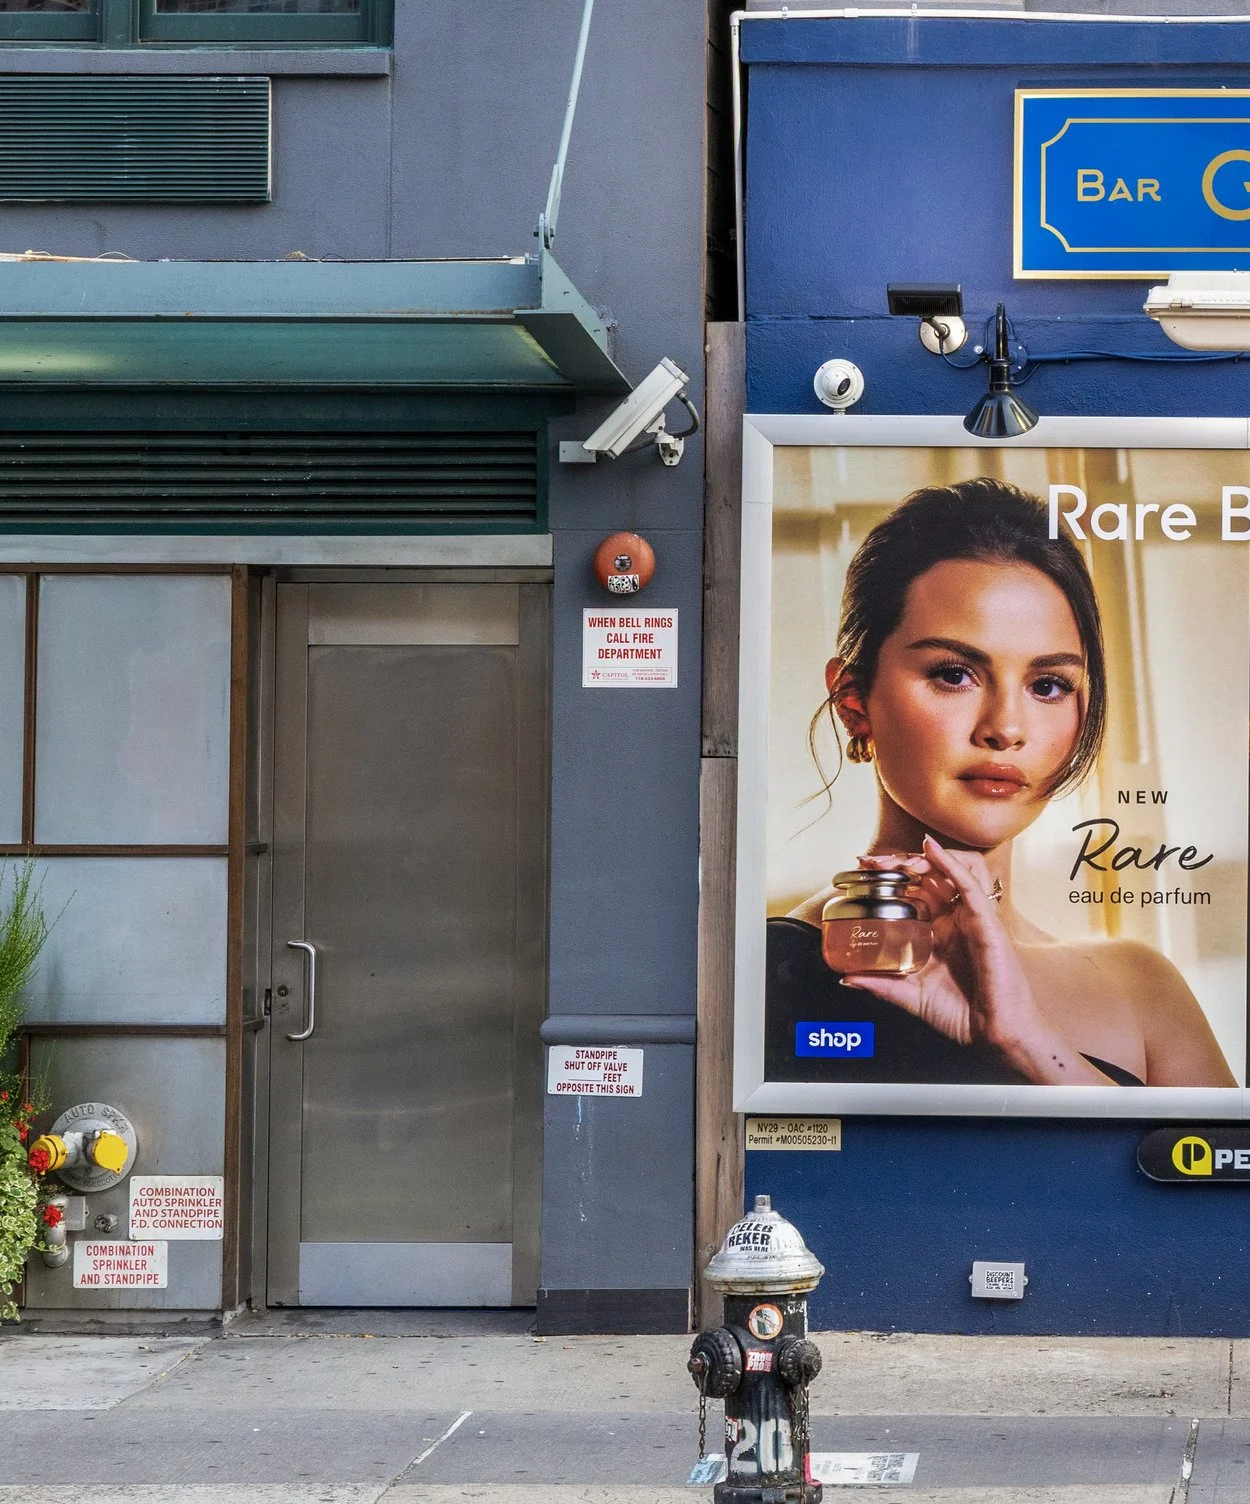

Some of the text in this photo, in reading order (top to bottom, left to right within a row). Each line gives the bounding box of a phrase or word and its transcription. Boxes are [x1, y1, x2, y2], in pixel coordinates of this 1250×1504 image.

[1047, 484, 1197, 542] Rare
[588, 617, 673, 628] WHEN BELL RINGS
[606, 633, 654, 644] CALL FIRE
[598, 648, 662, 659] DEPARTMENT
[1118, 791, 1168, 804] NEW
[1070, 818, 1214, 881] Rare
[1069, 887, 1211, 908] eau de parfum
[850, 926, 879, 939] Rare
[808, 1028, 862, 1051] shop
[576, 1050, 617, 1060] STANDPIPE
[564, 1061, 627, 1071] SHUT OFF VALVE
[603, 1073, 622, 1082] FEET
[556, 1083, 634, 1094] OPPOSITE THIS SIGN
[64, 1104, 94, 1123] AUTO
[757, 1123, 778, 1133] NY29
[788, 1124, 805, 1133] OAC
[807, 1124, 828, 1133] #1120
[748, 1134, 773, 1144] Permit
[139, 1188, 215, 1196] COMBINATION
[133, 1198, 222, 1207] AUTO SPRINKLER
[135, 1209, 219, 1217] AND STANDPIPE
[131, 1220, 223, 1228] F.D. CONNECTION
[86, 1245, 154, 1256] COMBINATION
[93, 1260, 147, 1271] SPRINKLER
[80, 1274, 159, 1284] AND STANDPIPE
[730, 1419, 793, 1474] 20
